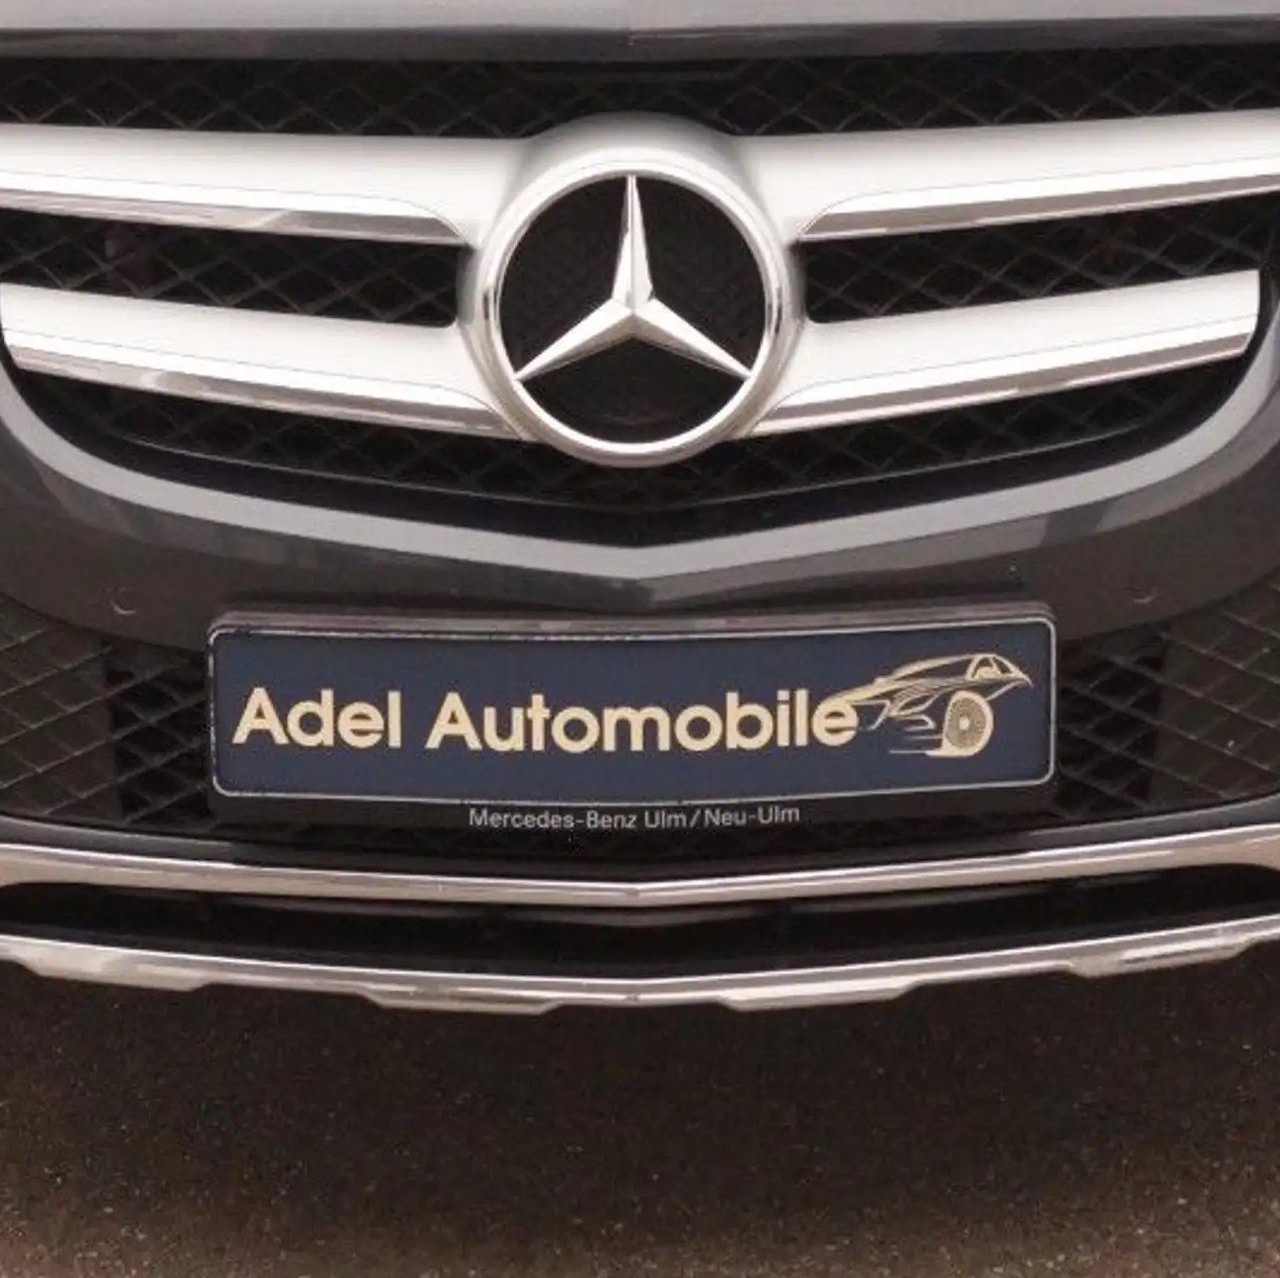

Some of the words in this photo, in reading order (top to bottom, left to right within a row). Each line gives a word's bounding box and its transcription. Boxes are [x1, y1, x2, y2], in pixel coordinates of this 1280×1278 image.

[231, 686, 402, 749] Adel
[424, 688, 859, 753] Automobile
[467, 807, 638, 830] Mercedes-Benz
